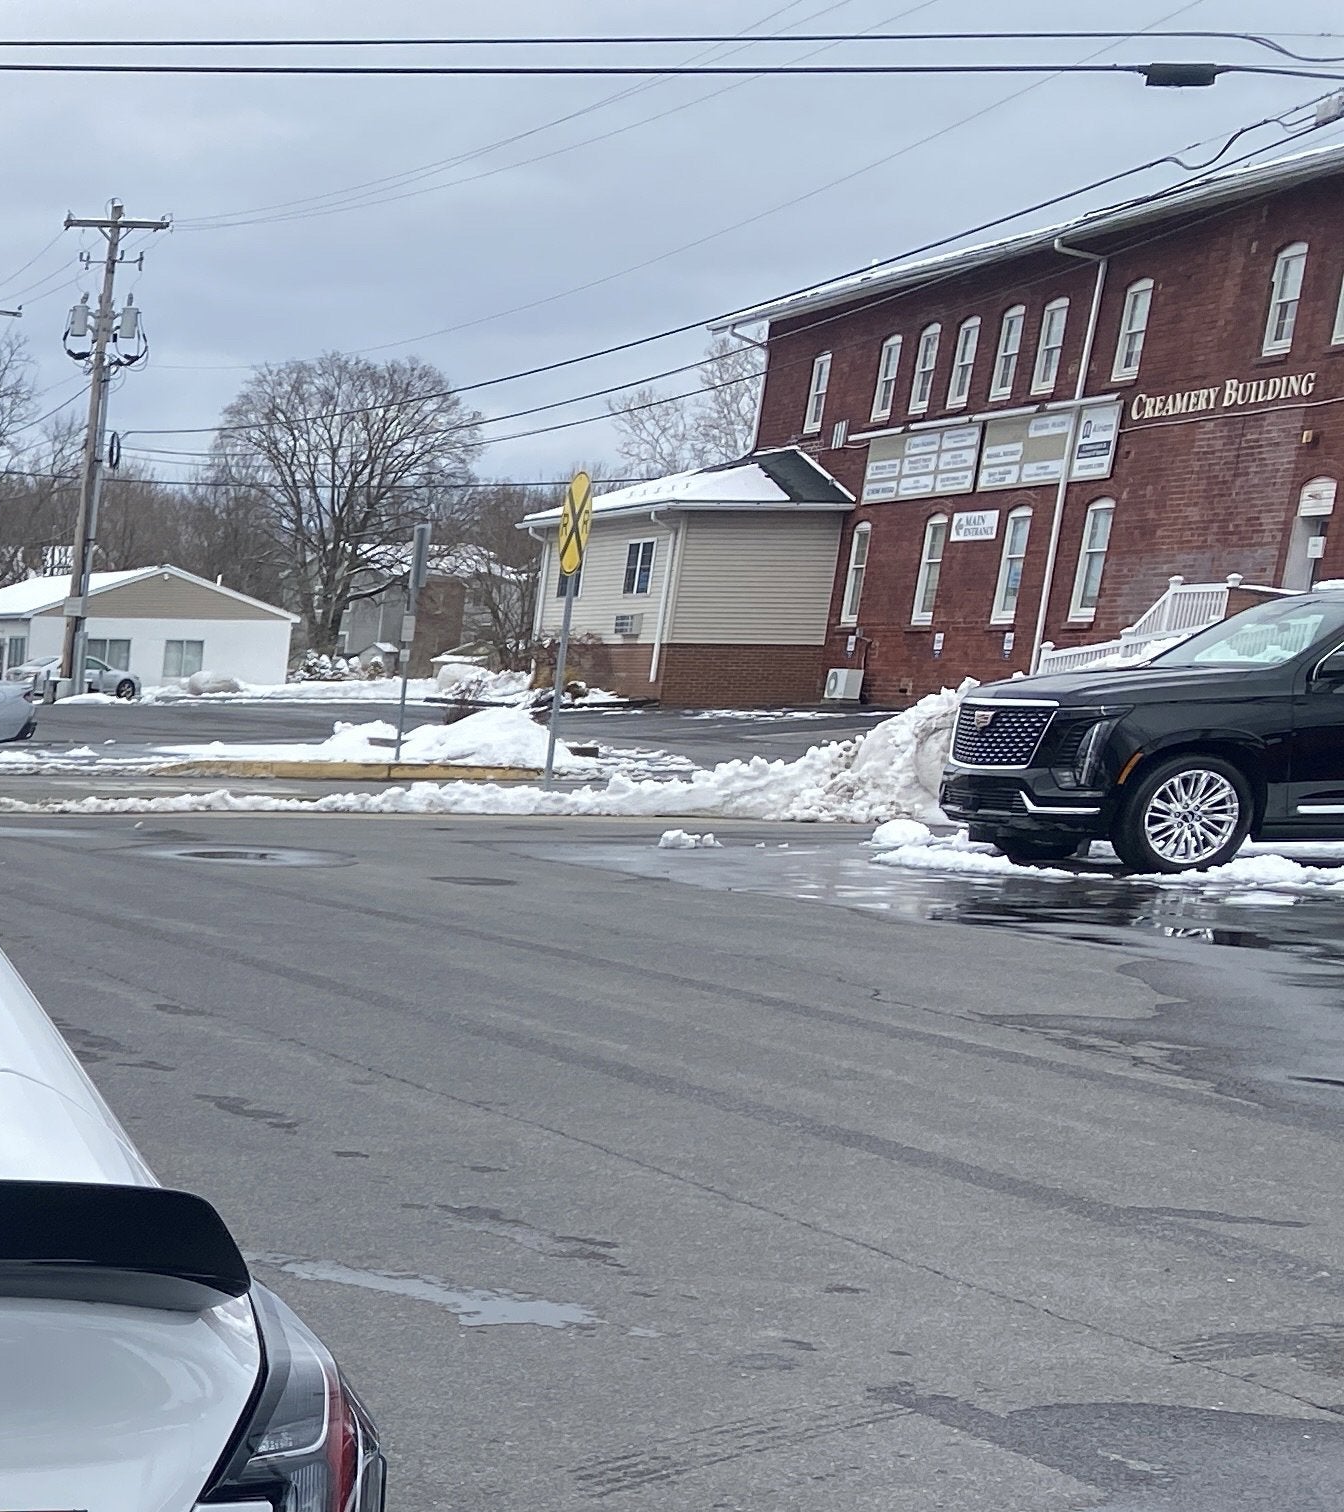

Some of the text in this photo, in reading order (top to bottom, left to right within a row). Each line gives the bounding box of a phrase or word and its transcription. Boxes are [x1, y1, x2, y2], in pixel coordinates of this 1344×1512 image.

[1130, 372, 1317, 421] CREAMERY BUILDING
[965, 514, 986, 526] MAIN
[963, 526, 995, 537] ENTRANCE
